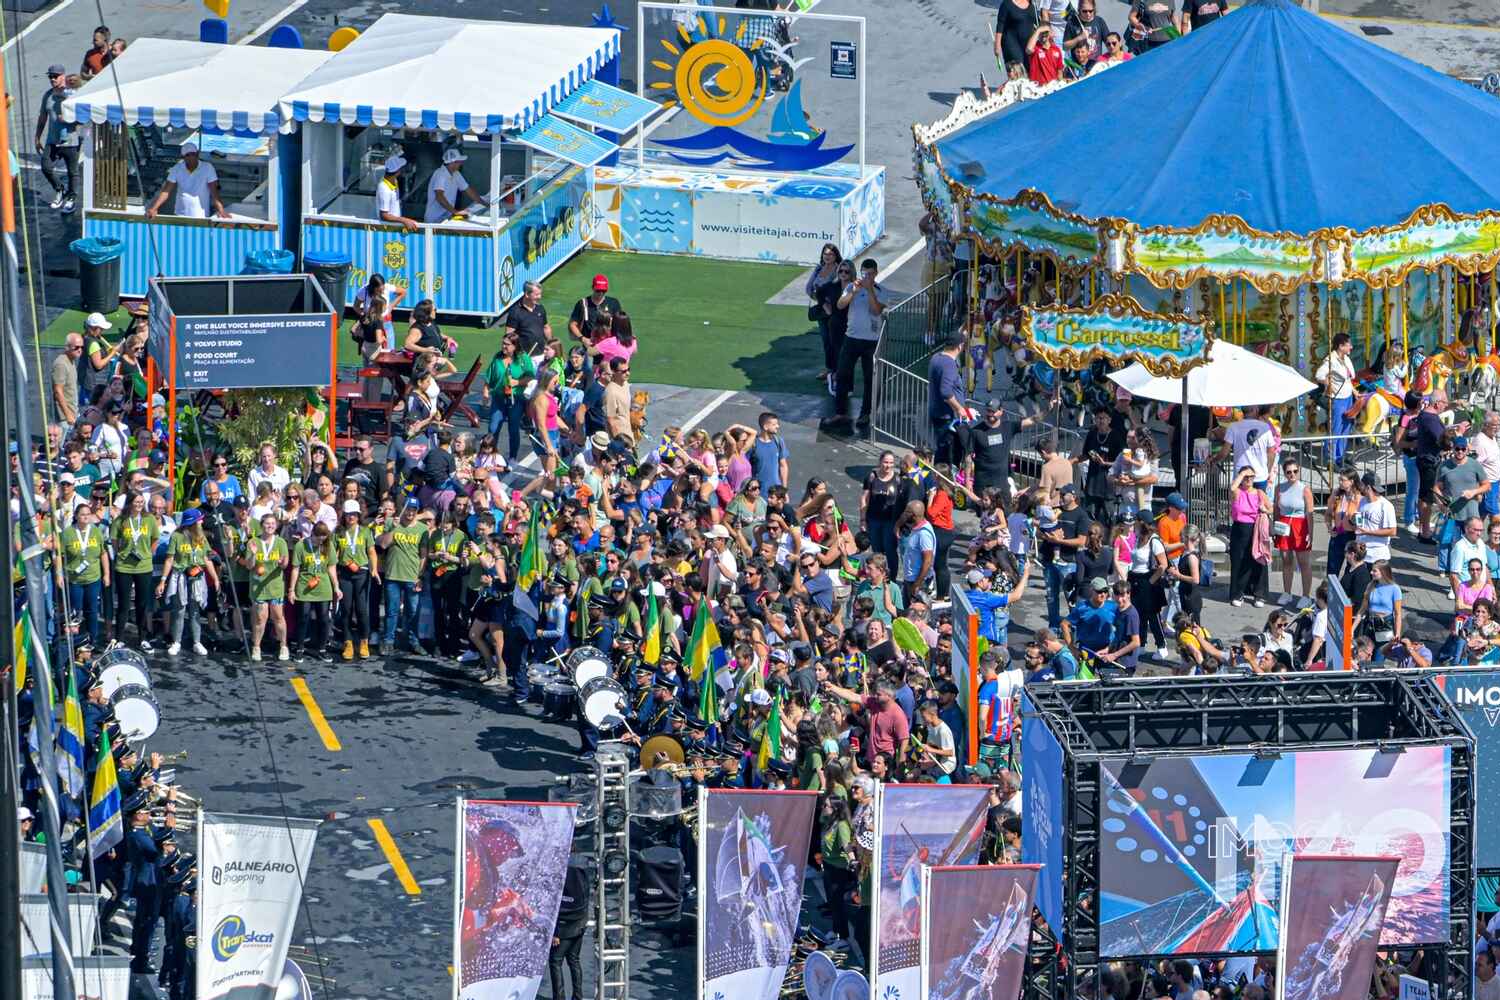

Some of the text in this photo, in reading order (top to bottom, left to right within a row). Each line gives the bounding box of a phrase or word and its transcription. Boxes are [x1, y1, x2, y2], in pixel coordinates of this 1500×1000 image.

[700, 222, 835, 242] www.visiteitajai.com.br
[1056, 319, 1181, 349] Carrossel
[223, 860, 295, 875] BALNEÁRIO
